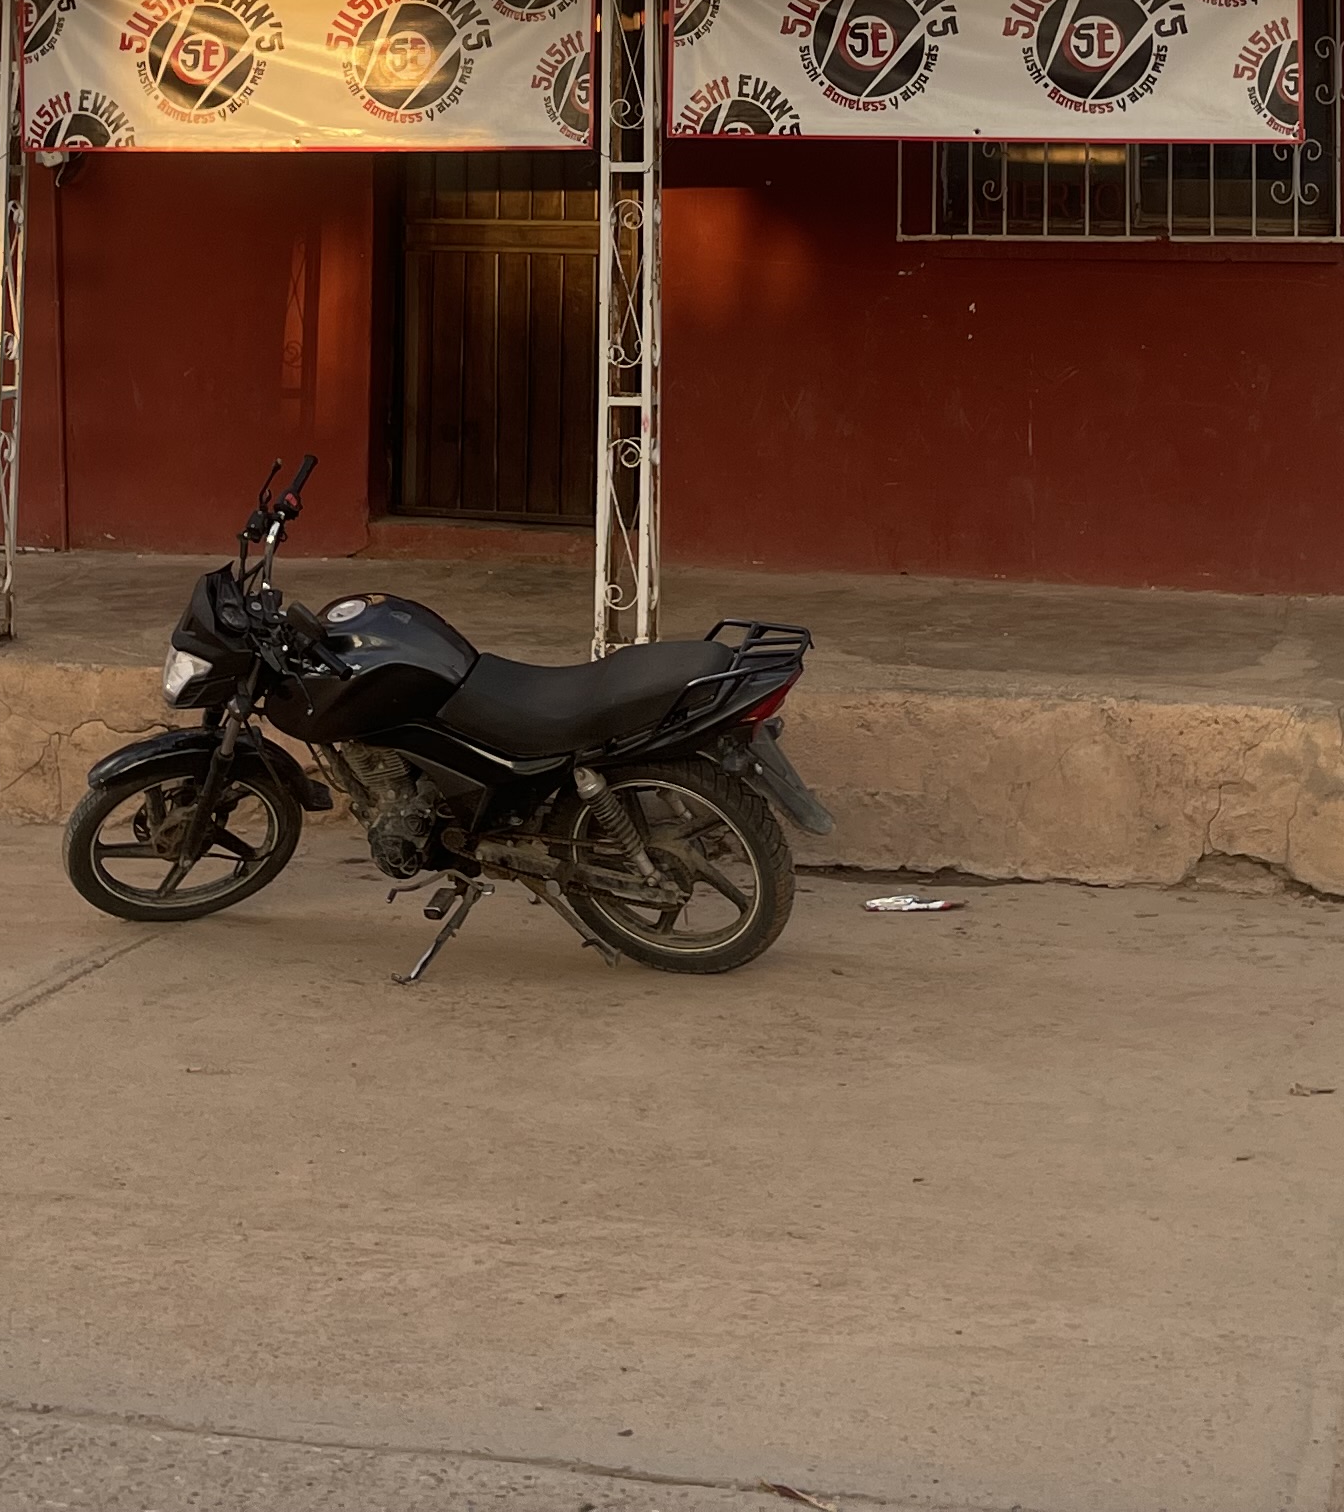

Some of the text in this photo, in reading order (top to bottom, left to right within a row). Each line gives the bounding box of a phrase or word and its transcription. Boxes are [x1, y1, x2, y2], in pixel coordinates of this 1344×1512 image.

[181, 39, 219, 72] SE
[848, 22, 888, 58] SE
[1073, 23, 1114, 59] SE
[1233, 17, 1291, 81] SUSHI
[531, 30, 584, 91] SUSHI
